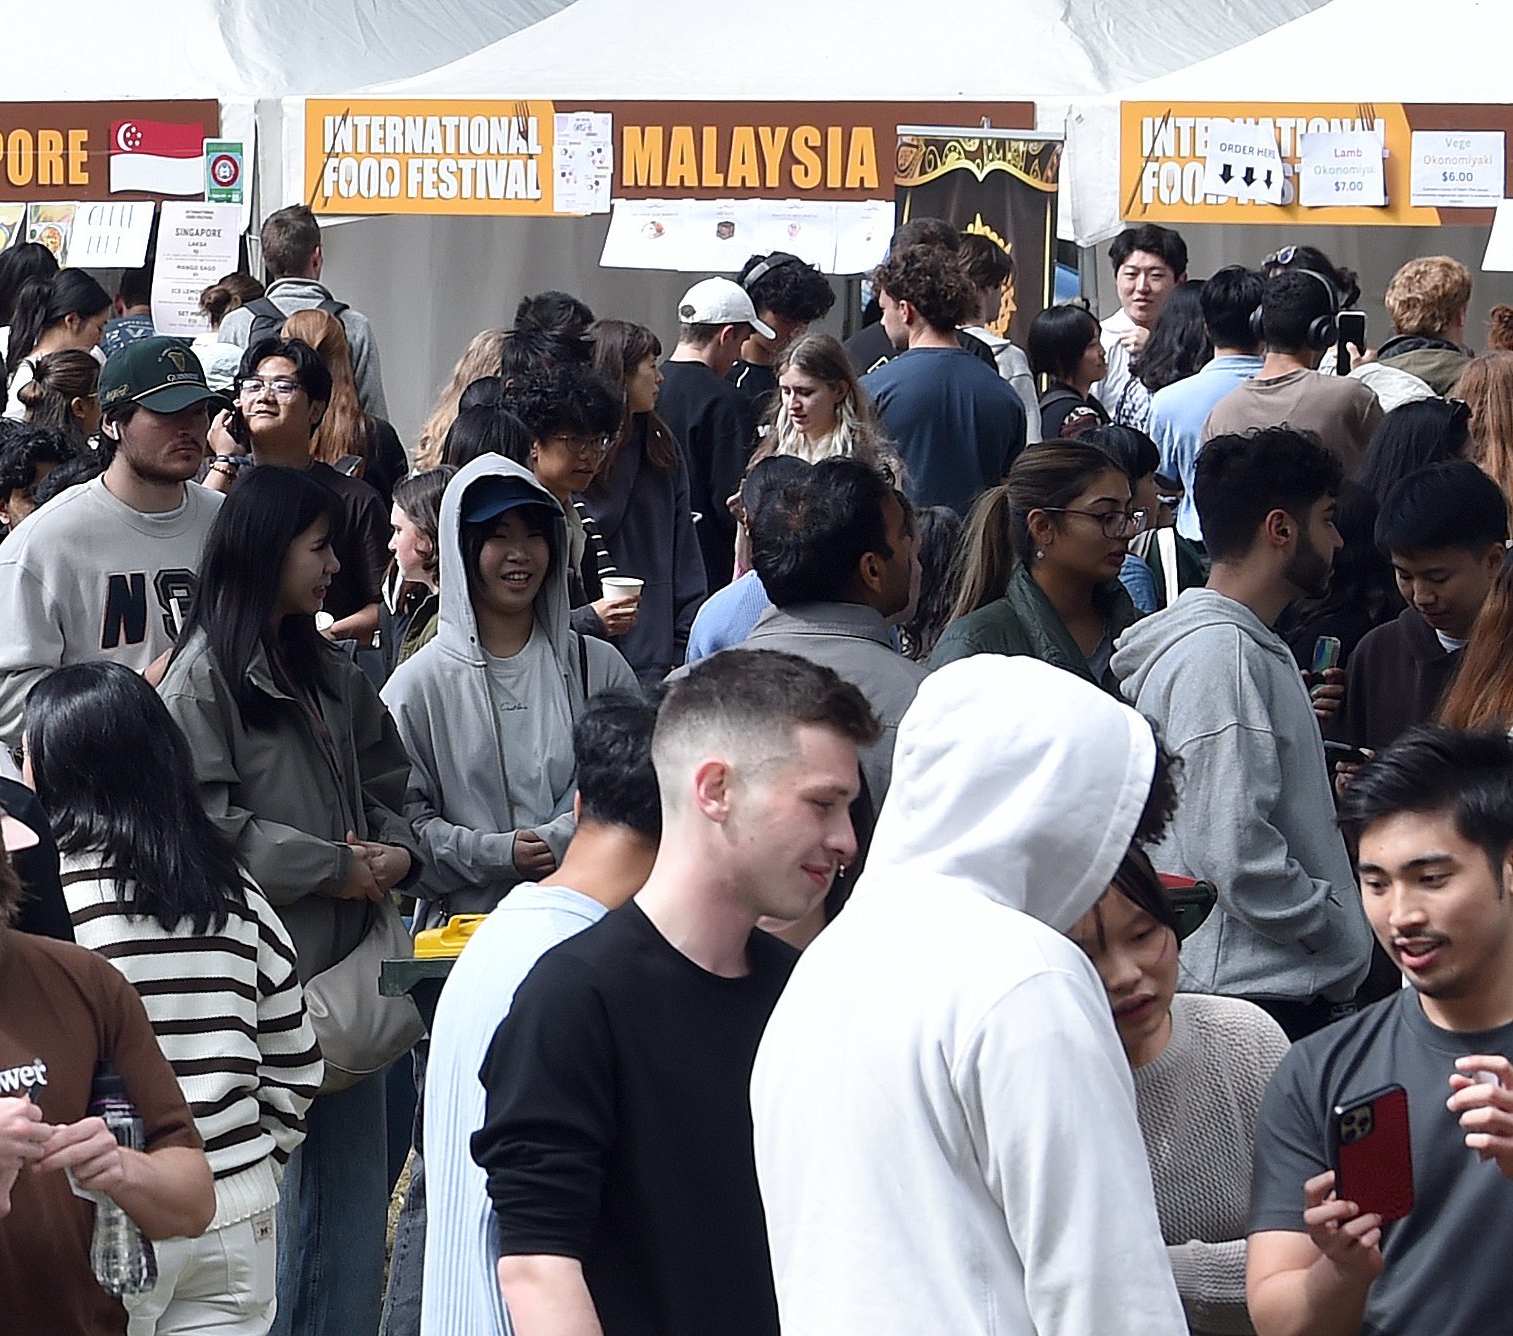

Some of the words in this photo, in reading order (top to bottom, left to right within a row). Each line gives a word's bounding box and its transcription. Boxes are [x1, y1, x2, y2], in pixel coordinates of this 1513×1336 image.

[324, 116, 542, 155] INTERNATIONAL
[1219, 142, 1255, 156] ORDER
[1445, 138, 1472, 150] Vege
[622, 125, 879, 189] MALAYSIA
[1334, 148, 1363, 158] Lamb
[323, 156, 401, 199] FOOD
[407, 158, 542, 199] FESTIVAL
[1141, 161, 1227, 205] FOO
[1442, 171, 1474, 183] $6.00
[1334, 181, 1364, 192] $7.00
[175, 228, 222, 238] SINGAPORE
